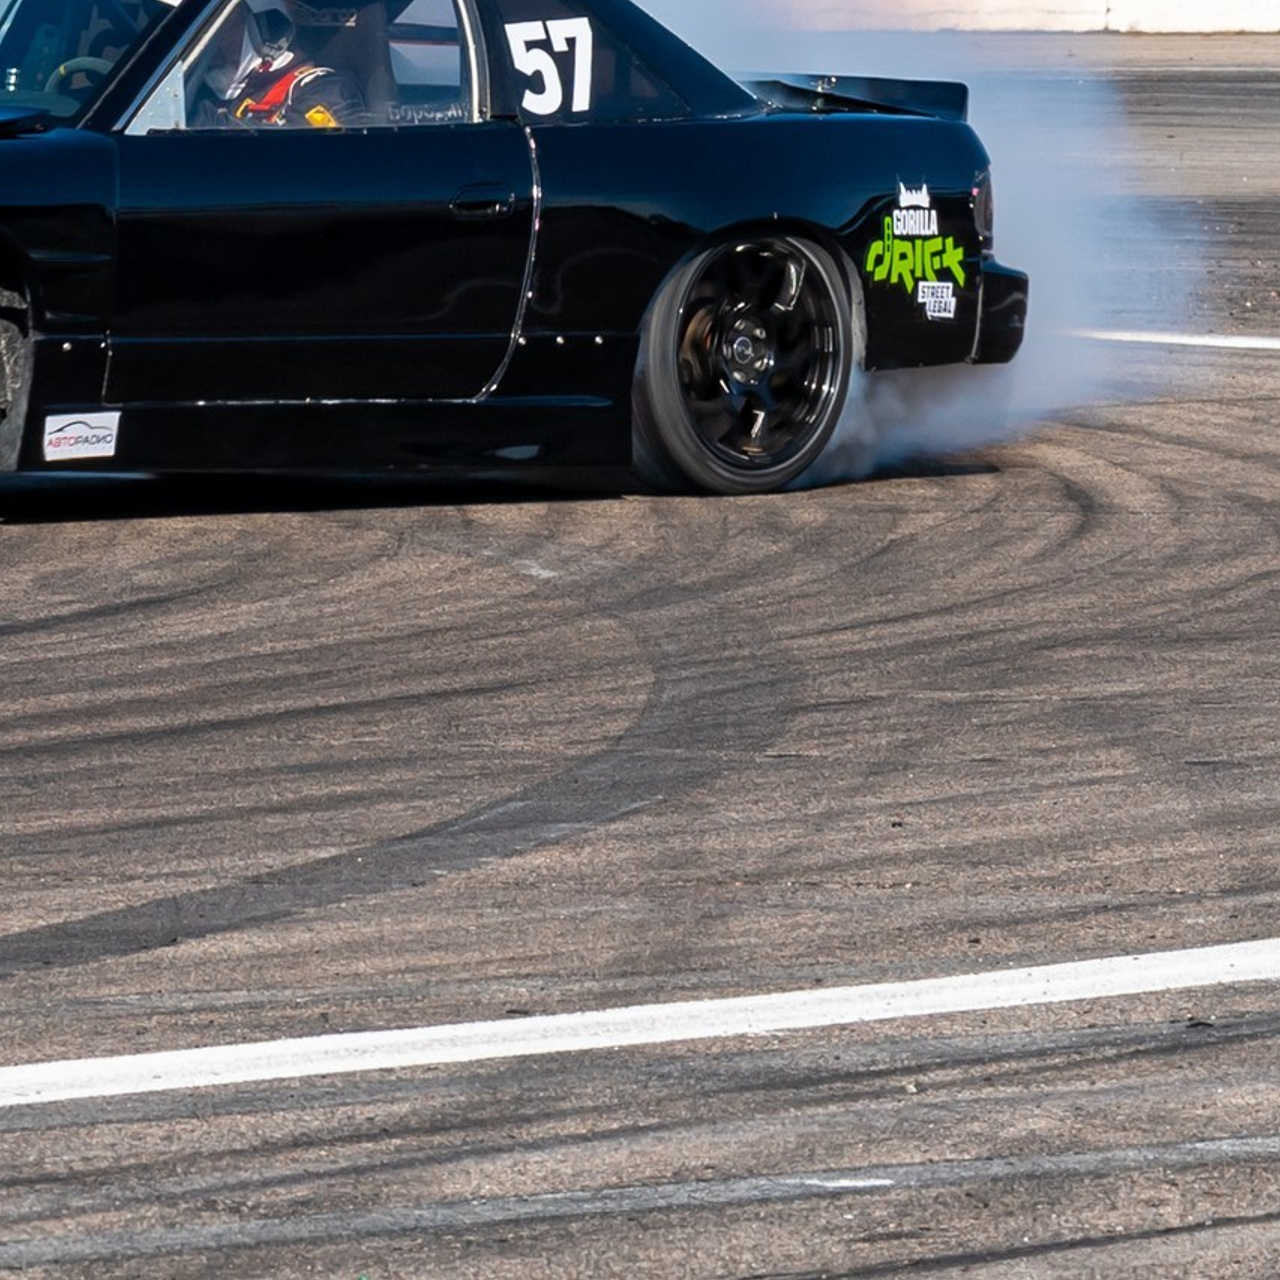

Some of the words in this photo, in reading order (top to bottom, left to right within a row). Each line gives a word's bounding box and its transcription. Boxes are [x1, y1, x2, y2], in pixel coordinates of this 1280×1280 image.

[504, 17, 593, 115] 57
[892, 209, 939, 236] GORILLA
[921, 285, 951, 299] STREET
[927, 300, 952, 314] LEGAL
[46, 433, 114, 449] АВТОРАДИО
